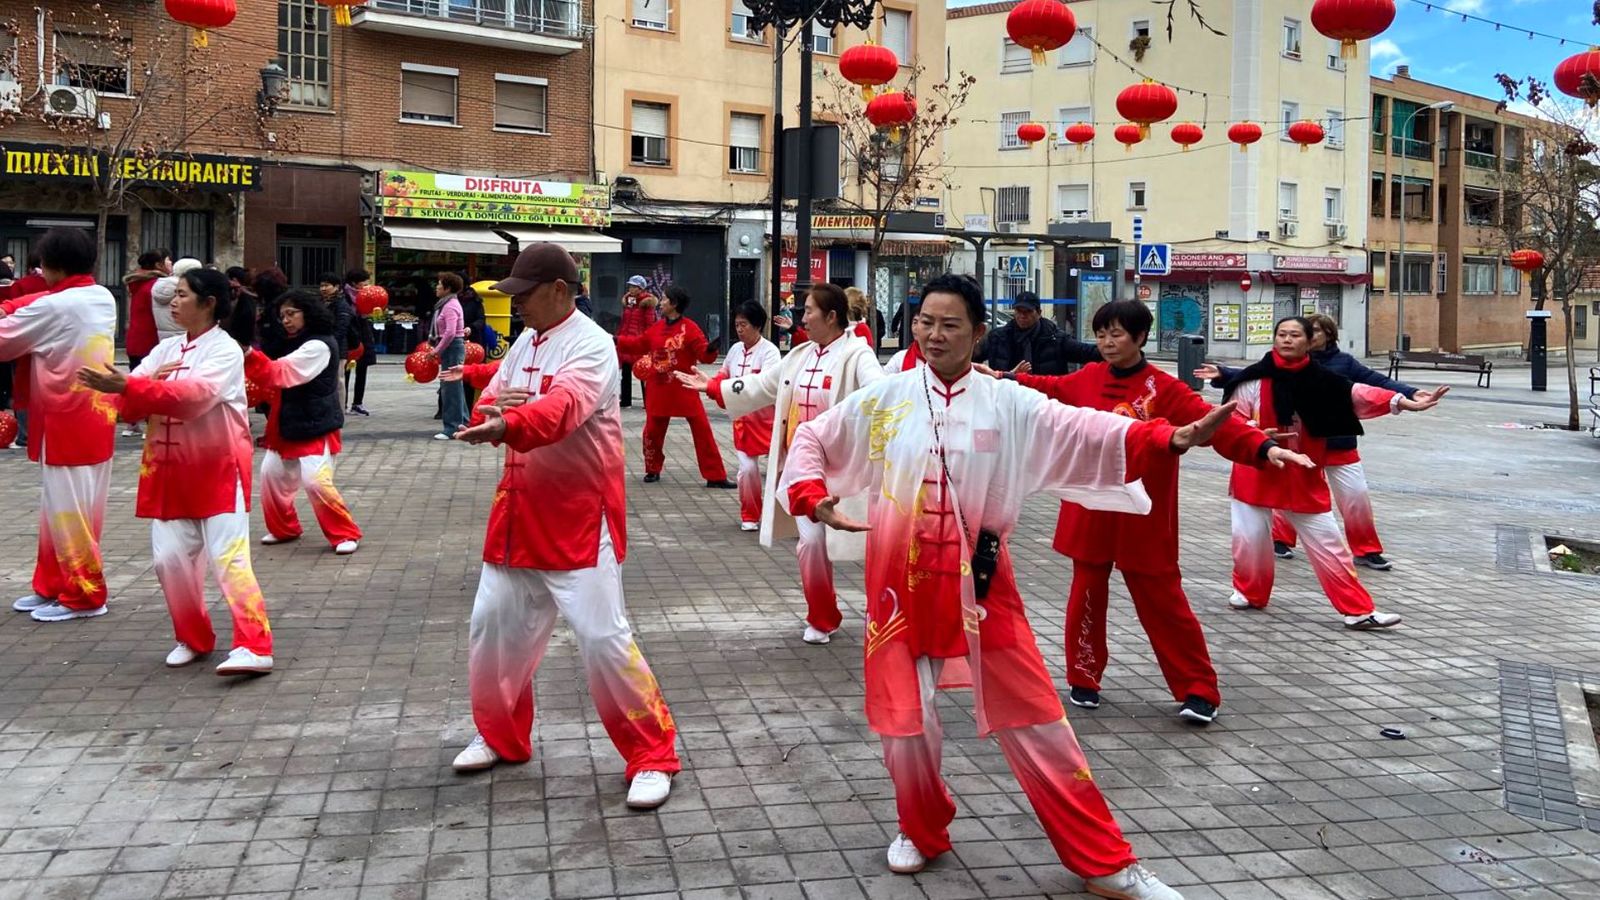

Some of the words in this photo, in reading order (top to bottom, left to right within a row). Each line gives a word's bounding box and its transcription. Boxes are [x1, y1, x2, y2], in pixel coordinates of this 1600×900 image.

[465, 178, 543, 194] DISFRUTA
[446, 191, 476, 199] VERDURAS
[526, 195, 557, 203] PRODUCTOS
[420, 209, 464, 218] SERVICIO
[466, 211, 473, 219] A
[475, 212, 521, 221] DOMICILIO
[813, 215, 877, 228] IMENTACION
[1181, 254, 1207, 262] DONER
